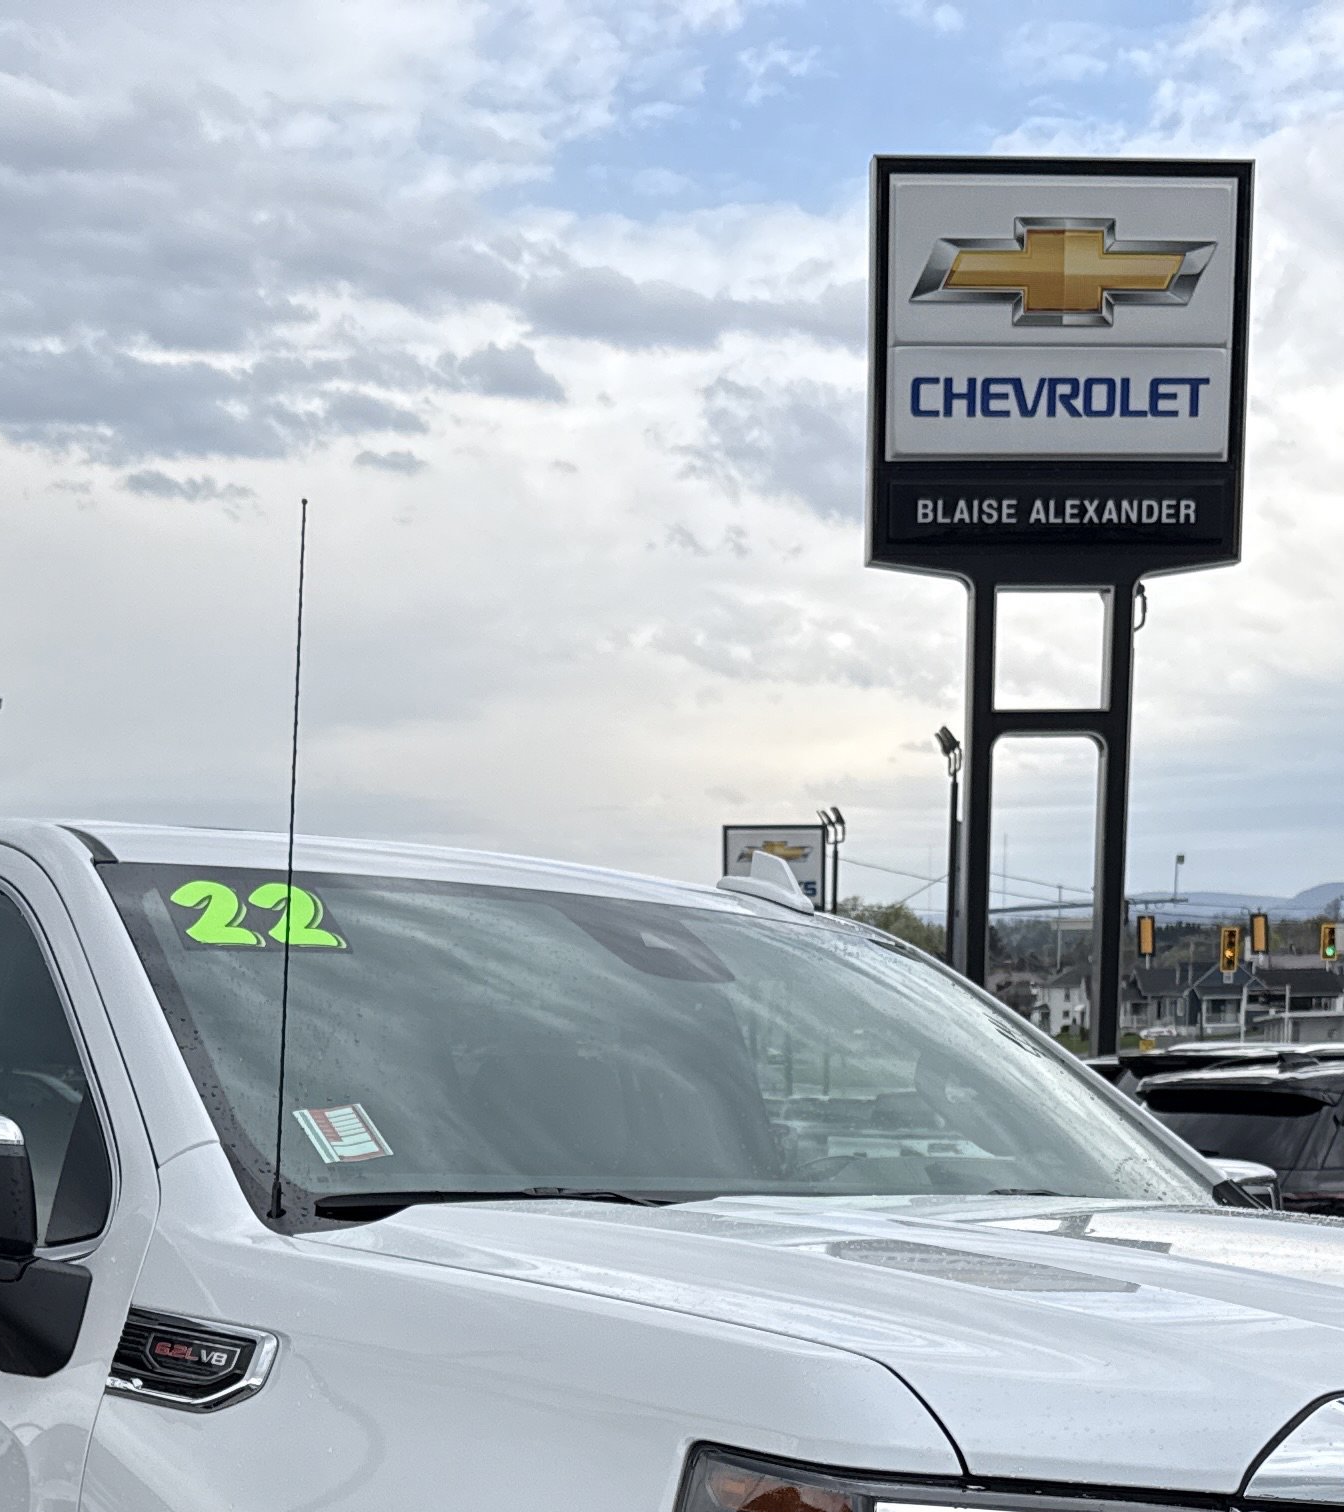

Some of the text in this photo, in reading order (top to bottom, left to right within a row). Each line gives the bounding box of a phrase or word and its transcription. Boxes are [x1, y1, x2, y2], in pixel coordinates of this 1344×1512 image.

[911, 377, 1210, 418] CHEVROLET
[916, 500, 1196, 524] BLAISE ALEXANDER
[170, 880, 347, 949] 22
[201, 1349, 227, 1366] V8
